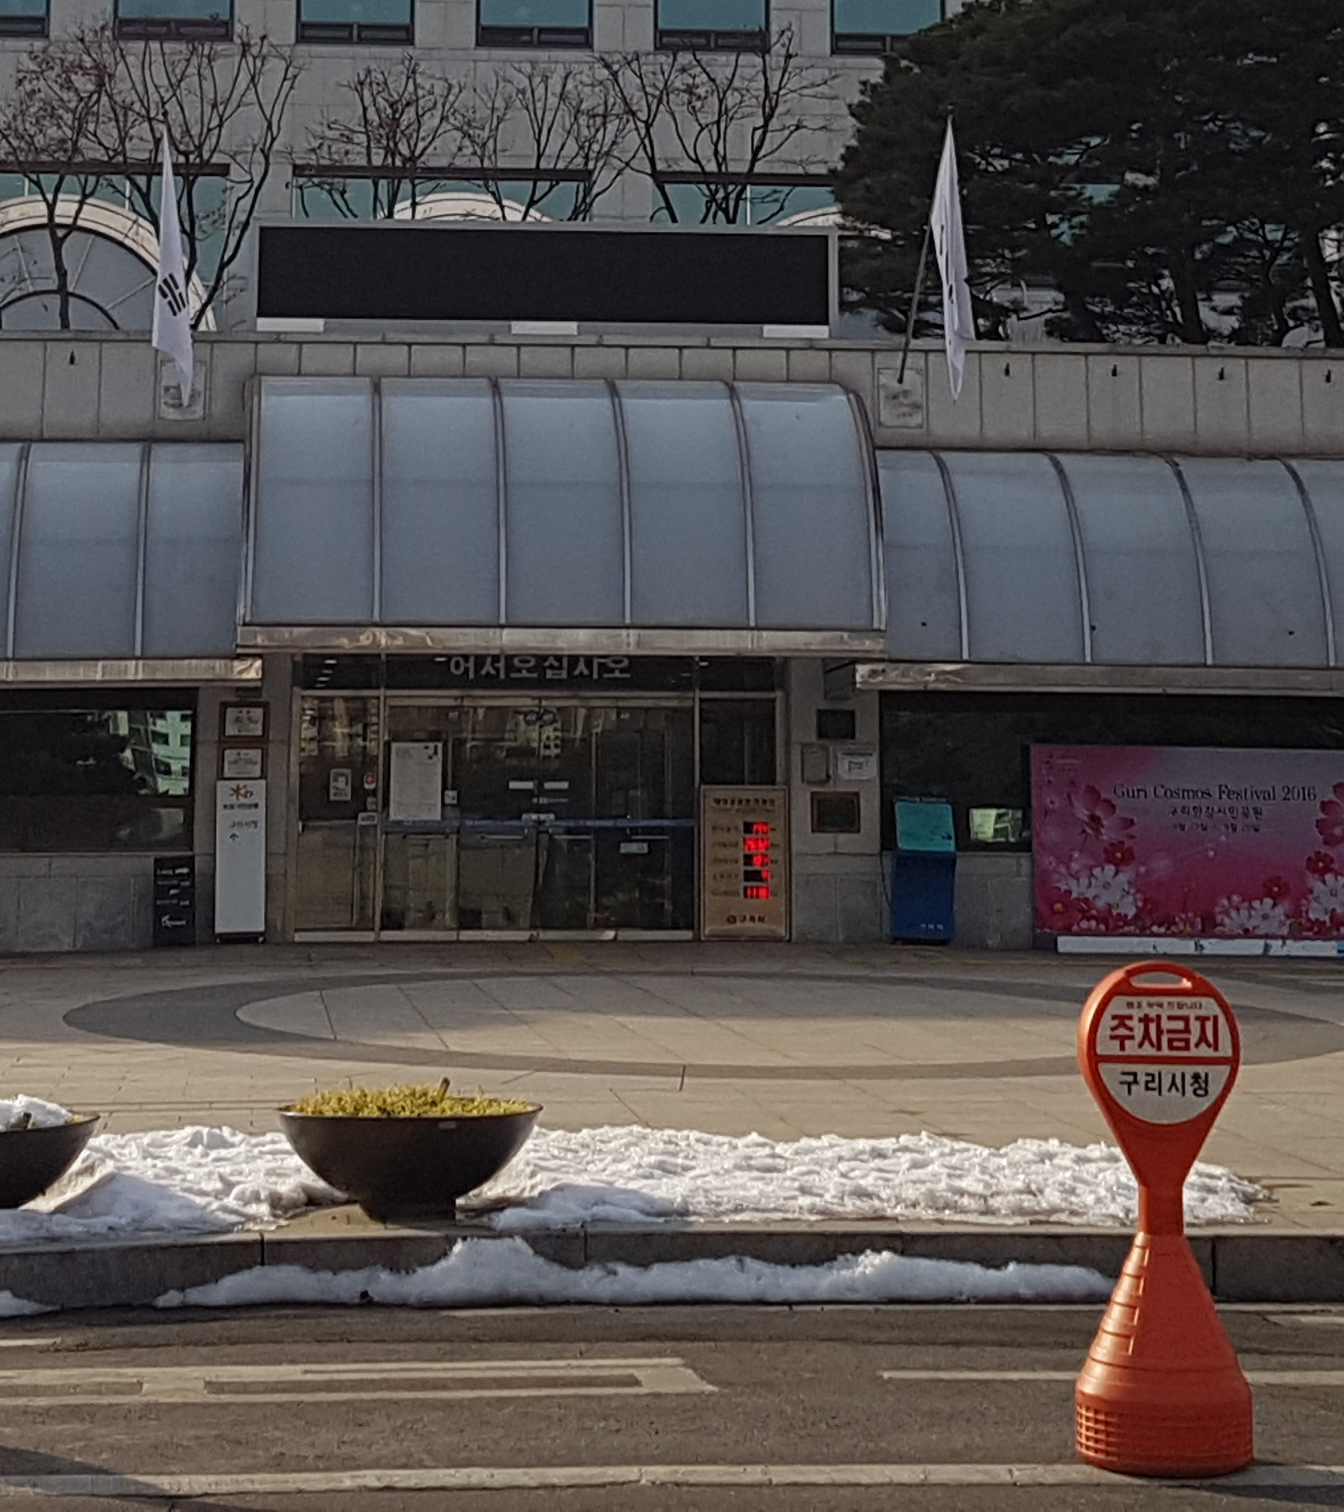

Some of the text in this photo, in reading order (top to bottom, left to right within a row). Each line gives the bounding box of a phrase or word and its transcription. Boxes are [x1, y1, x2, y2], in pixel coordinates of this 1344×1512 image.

[449, 654, 632, 680] 어서오십시오
[1113, 783, 1317, 802] Guri Cosmos Festival 2016
[1109, 1013, 1219, 1053] 주차금지
[1119, 1070, 1210, 1098] 구리시청
